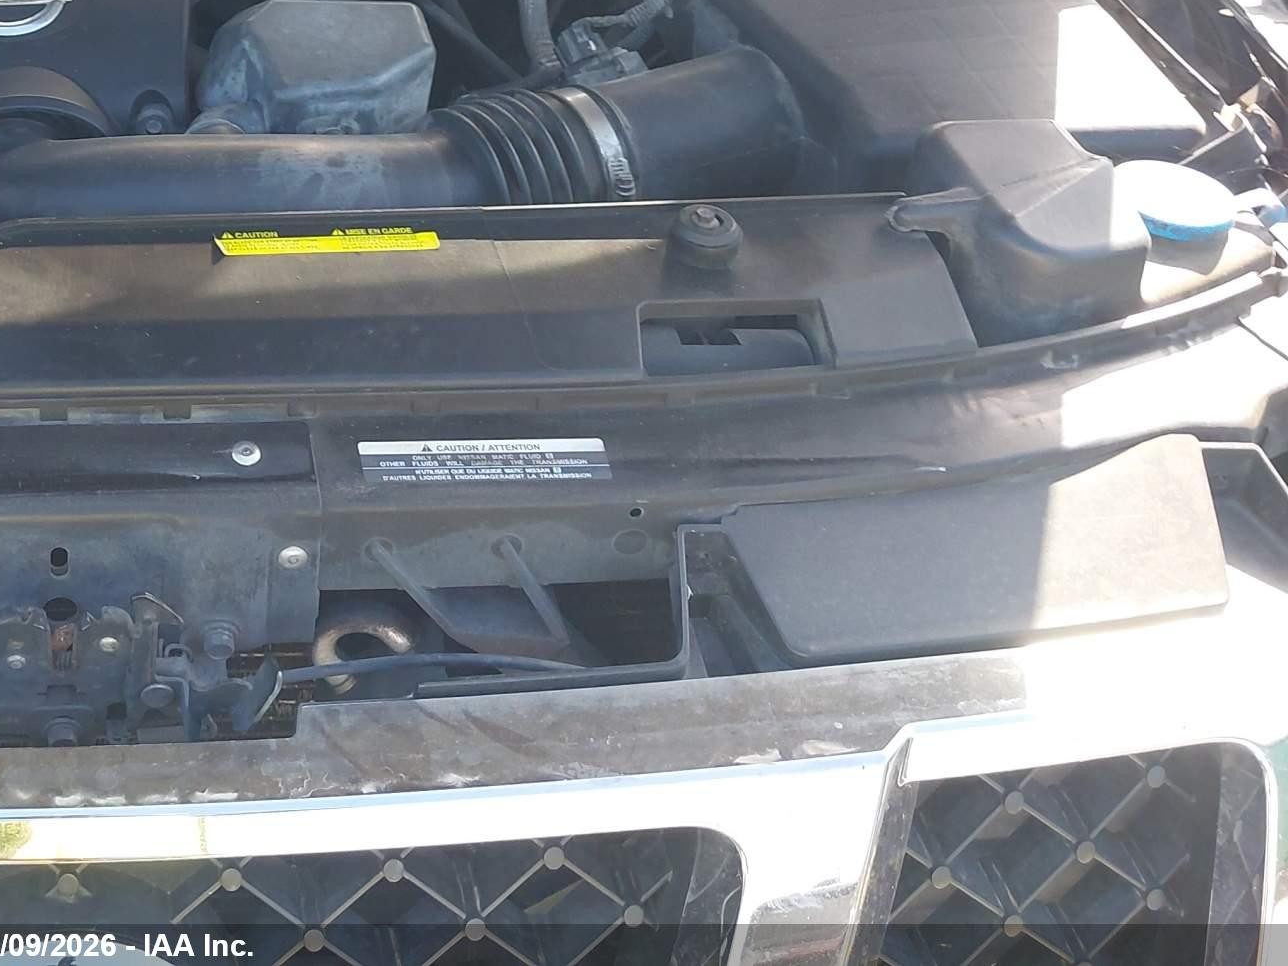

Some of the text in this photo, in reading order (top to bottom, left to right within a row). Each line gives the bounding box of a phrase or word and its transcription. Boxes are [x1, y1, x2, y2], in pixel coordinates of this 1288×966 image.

[234, 231, 279, 239] CAUTION
[436, 444, 479, 452] CAUTION
[488, 443, 541, 451] ATTENTION
